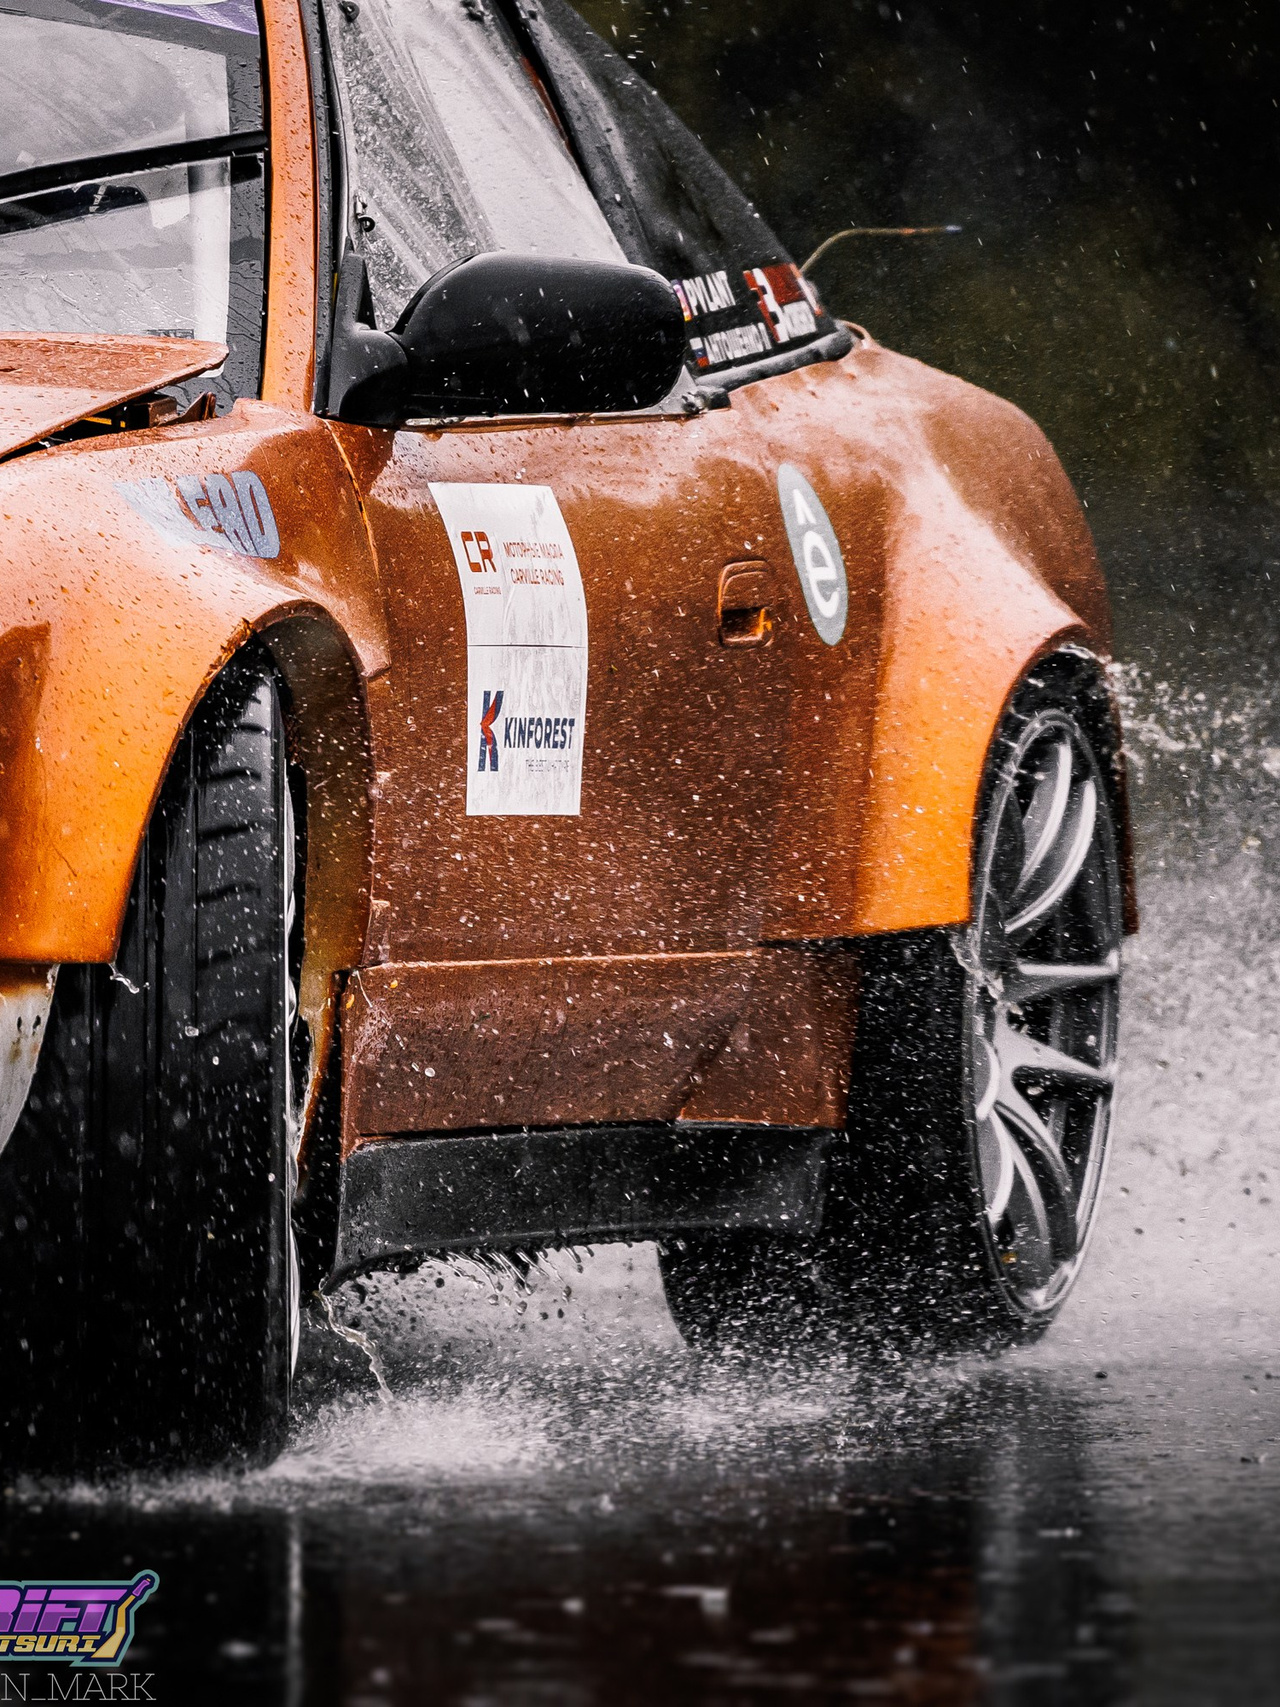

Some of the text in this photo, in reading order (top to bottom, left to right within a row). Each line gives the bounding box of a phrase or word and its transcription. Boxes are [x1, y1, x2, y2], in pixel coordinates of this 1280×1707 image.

[460, 530, 497, 574] CR
[509, 567, 565, 586] CARVILLE RACING
[503, 716, 576, 750] KINFOREST
